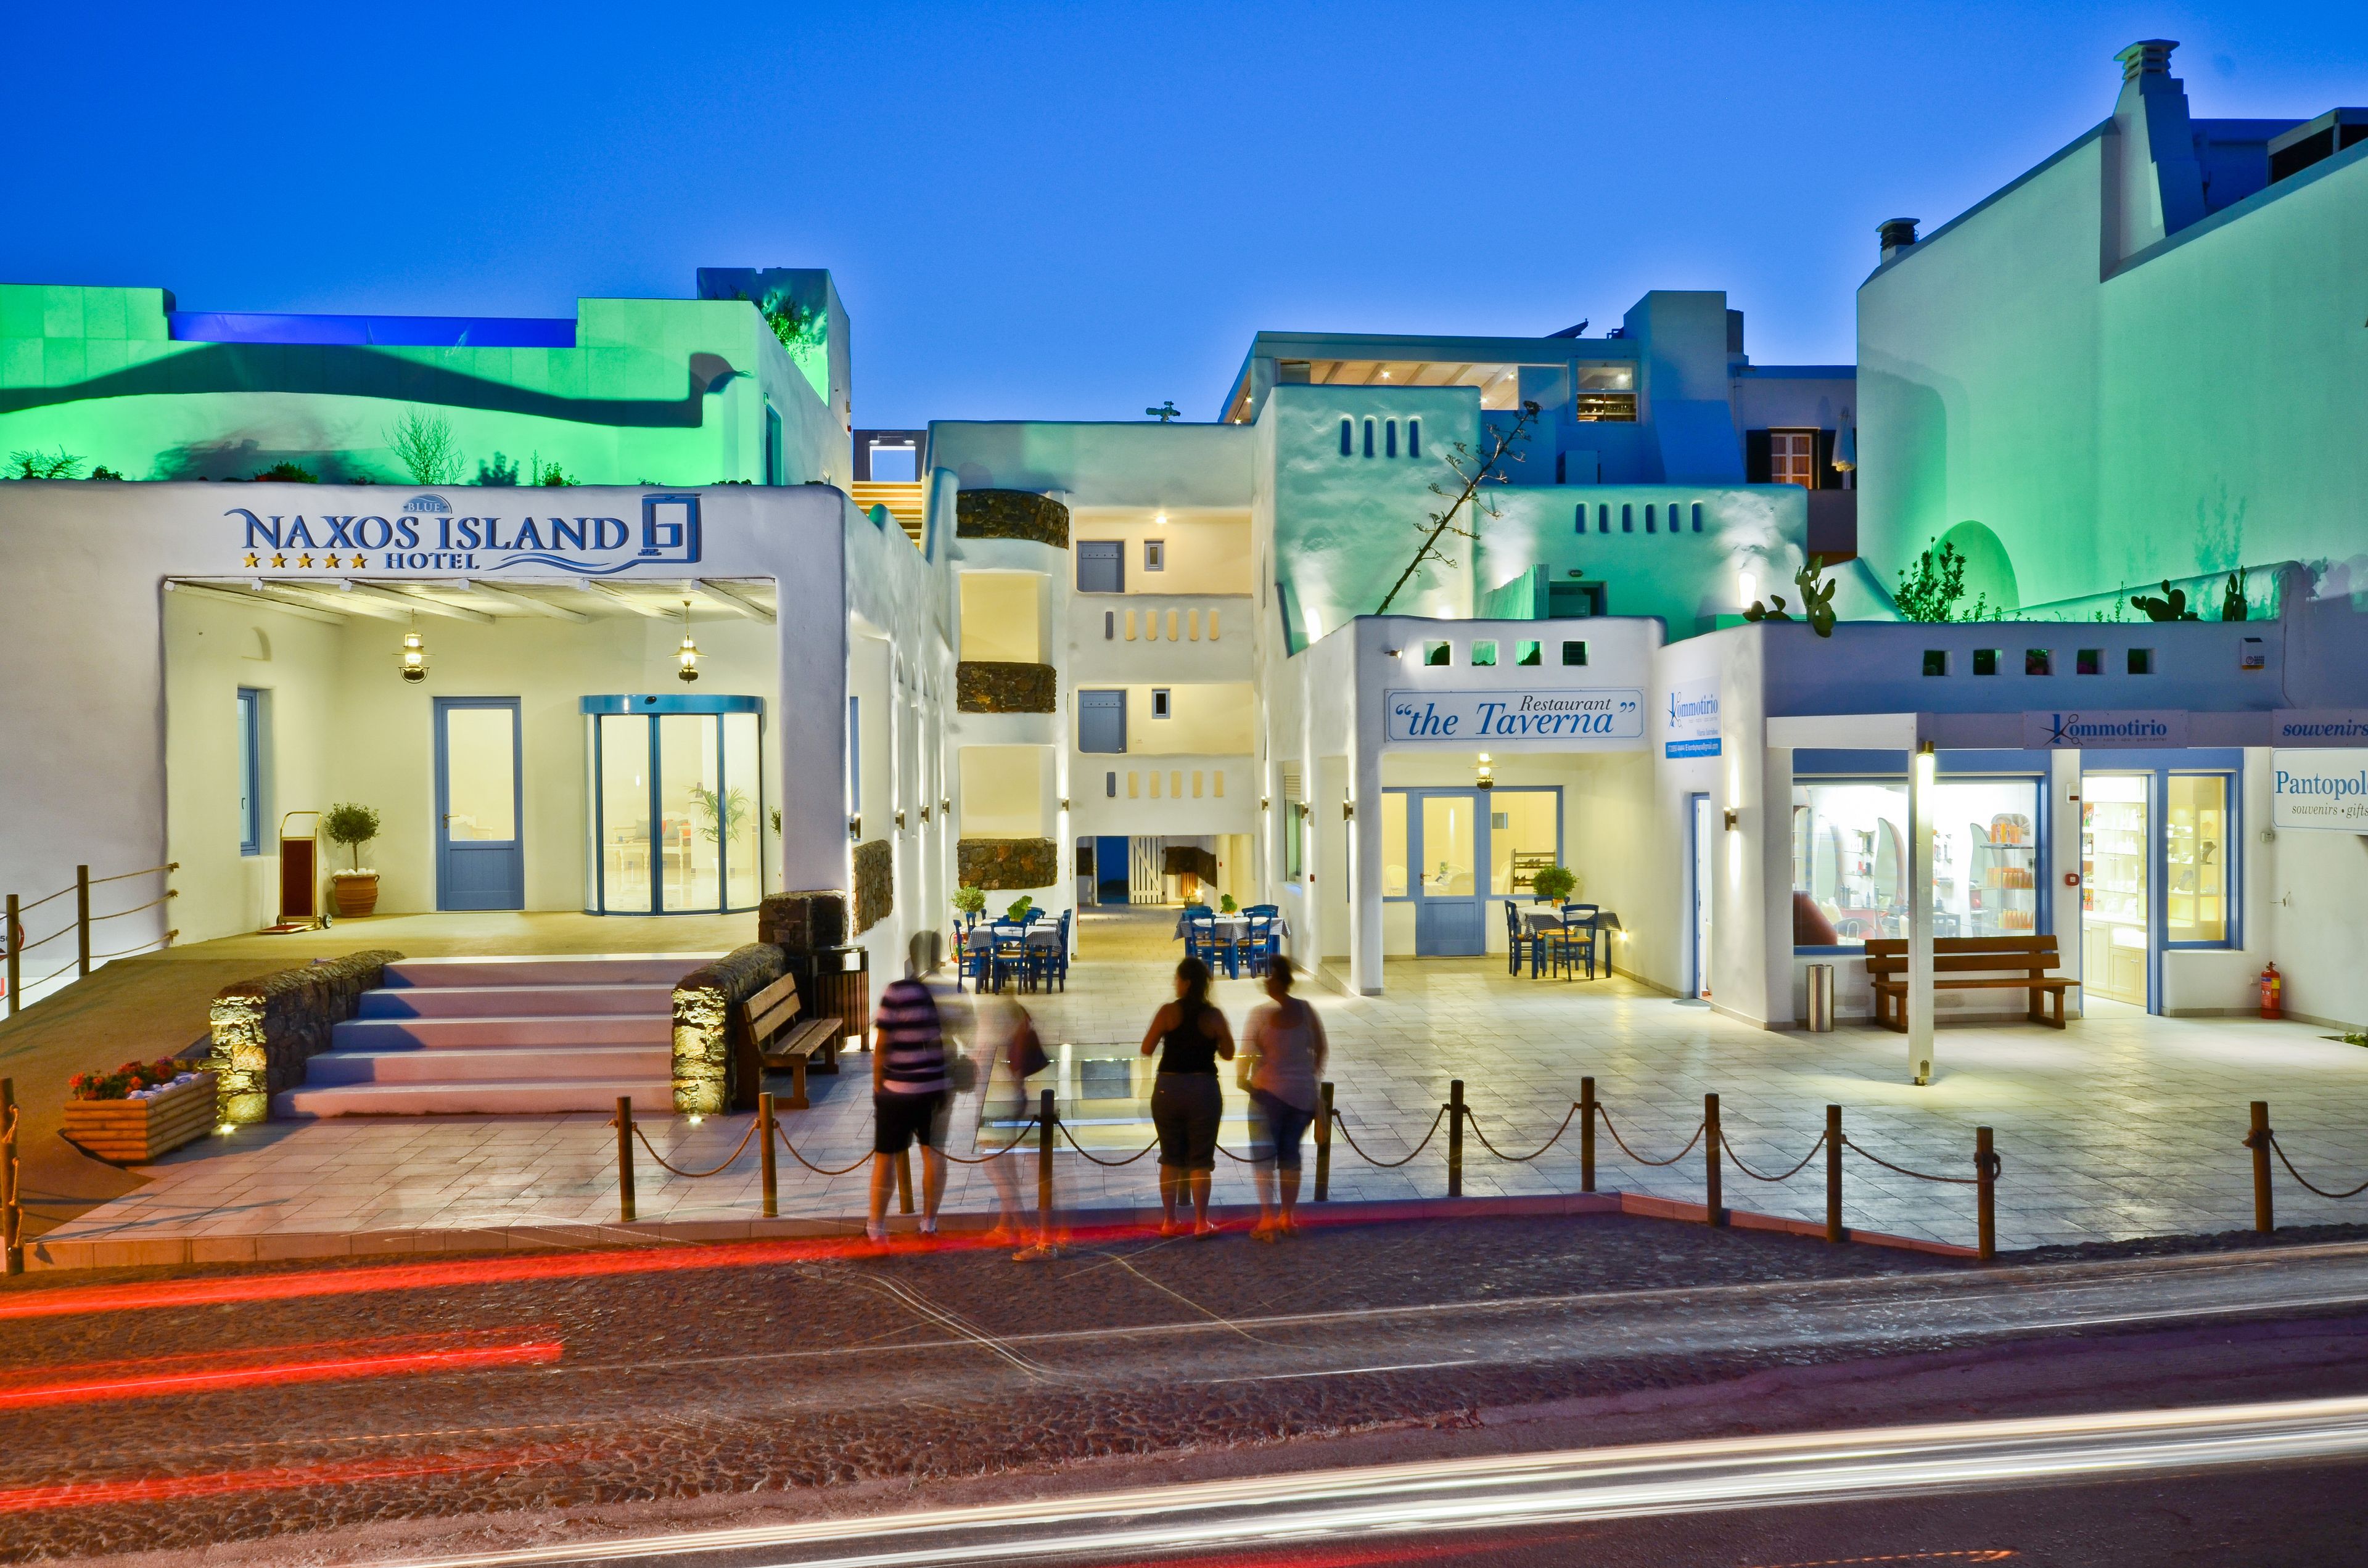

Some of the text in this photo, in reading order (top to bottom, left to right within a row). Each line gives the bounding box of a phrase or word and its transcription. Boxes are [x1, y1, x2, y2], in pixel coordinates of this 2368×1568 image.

[408, 502, 441, 512] BLUE
[224, 508, 629, 551] NAXOS ISLAND
[384, 552, 480, 570] HOTEL
[1519, 695, 1612, 711] Restaurant
[2283, 719, 2368, 736] souvenirs
[2275, 770, 2368, 800] Pantopol
[2292, 802, 2338, 816] souvenirs
